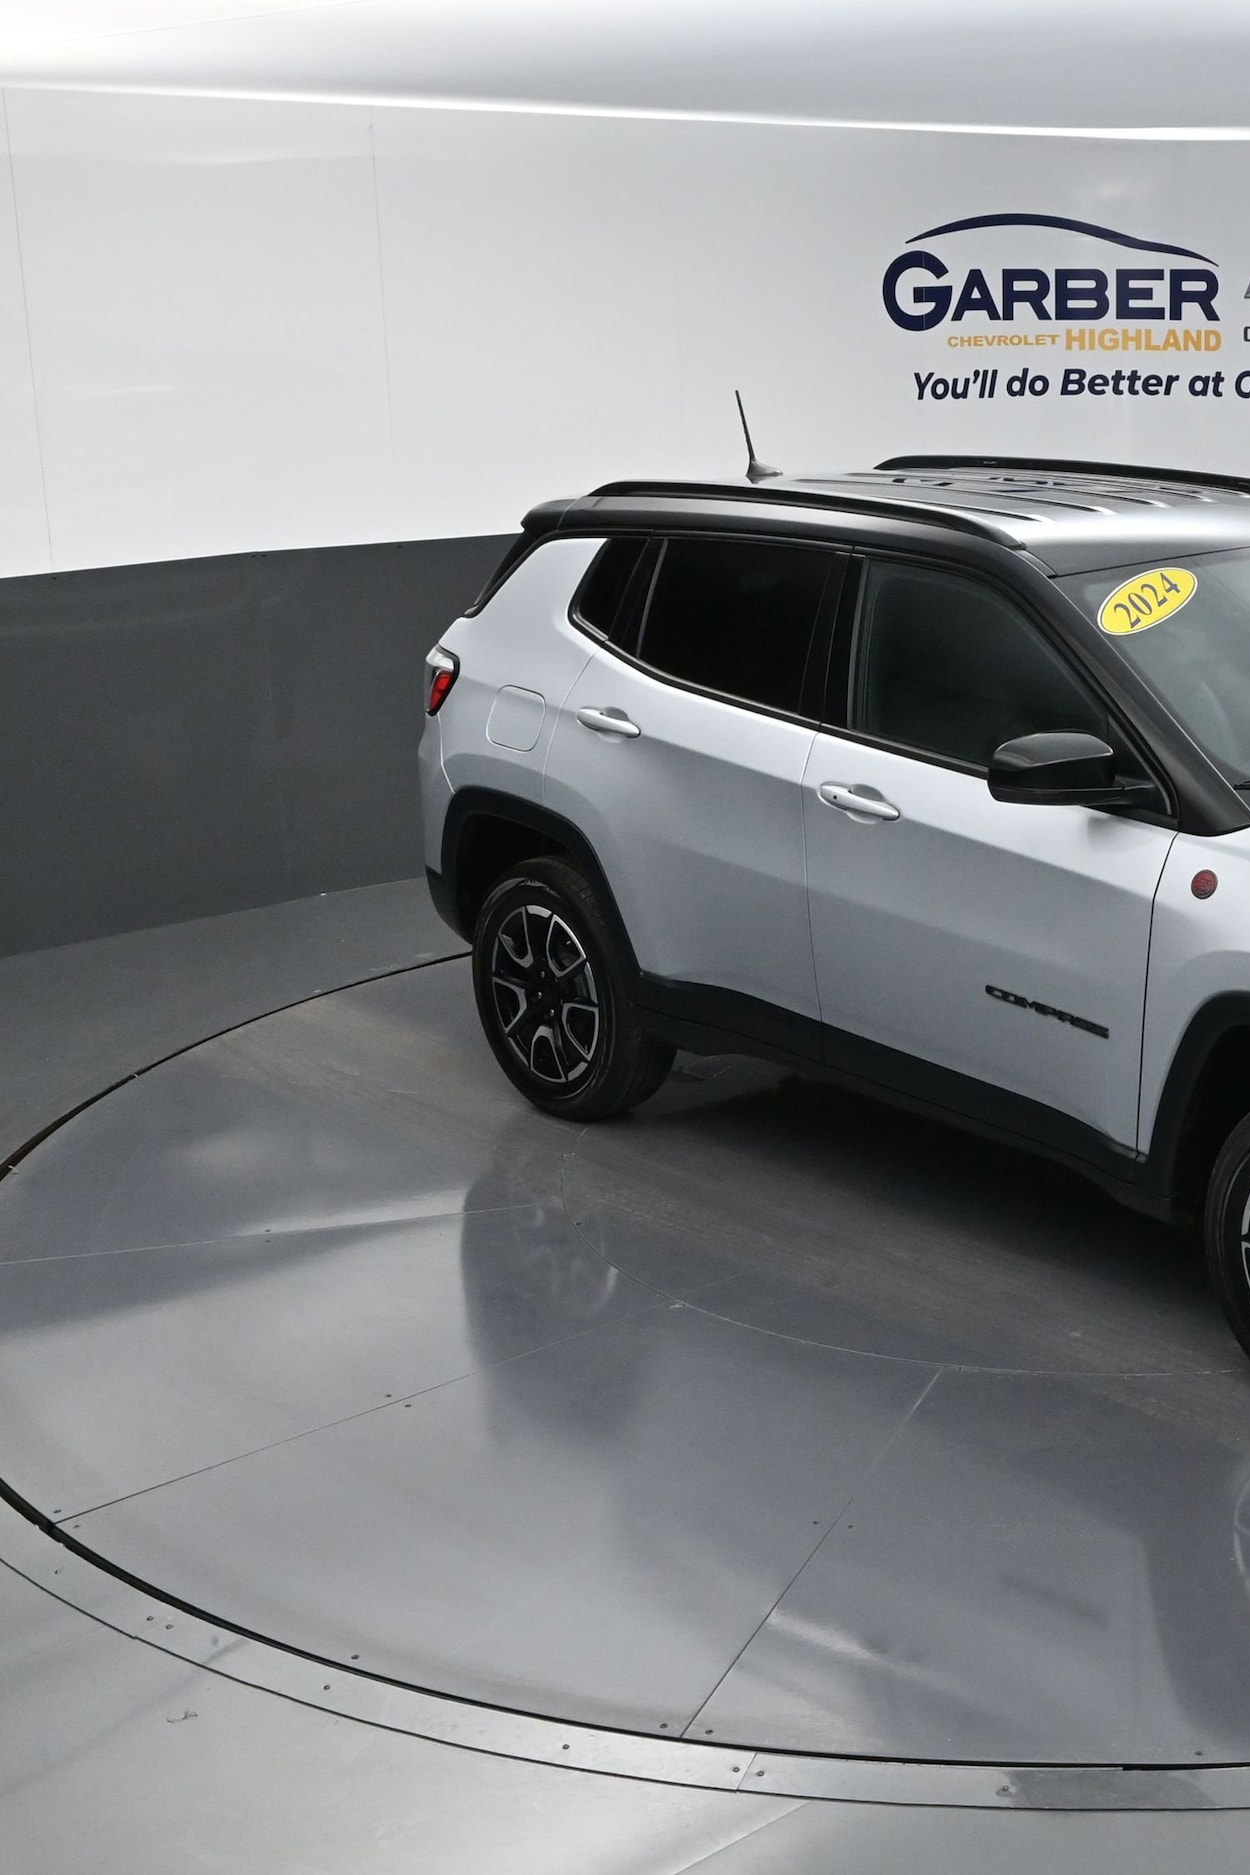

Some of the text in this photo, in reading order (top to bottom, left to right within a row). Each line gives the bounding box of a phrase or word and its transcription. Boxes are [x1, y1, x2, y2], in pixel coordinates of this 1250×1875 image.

[883, 250, 1220, 332] GARBER
[947, 327, 1223, 352] CHEVROLET HIGHLAND
[914, 369, 998, 401] You'll
[1006, 367, 1050, 398] do
[1060, 368, 1180, 396] Better
[1188, 370, 1225, 397] at
[1113, 572, 1181, 629] 2024
